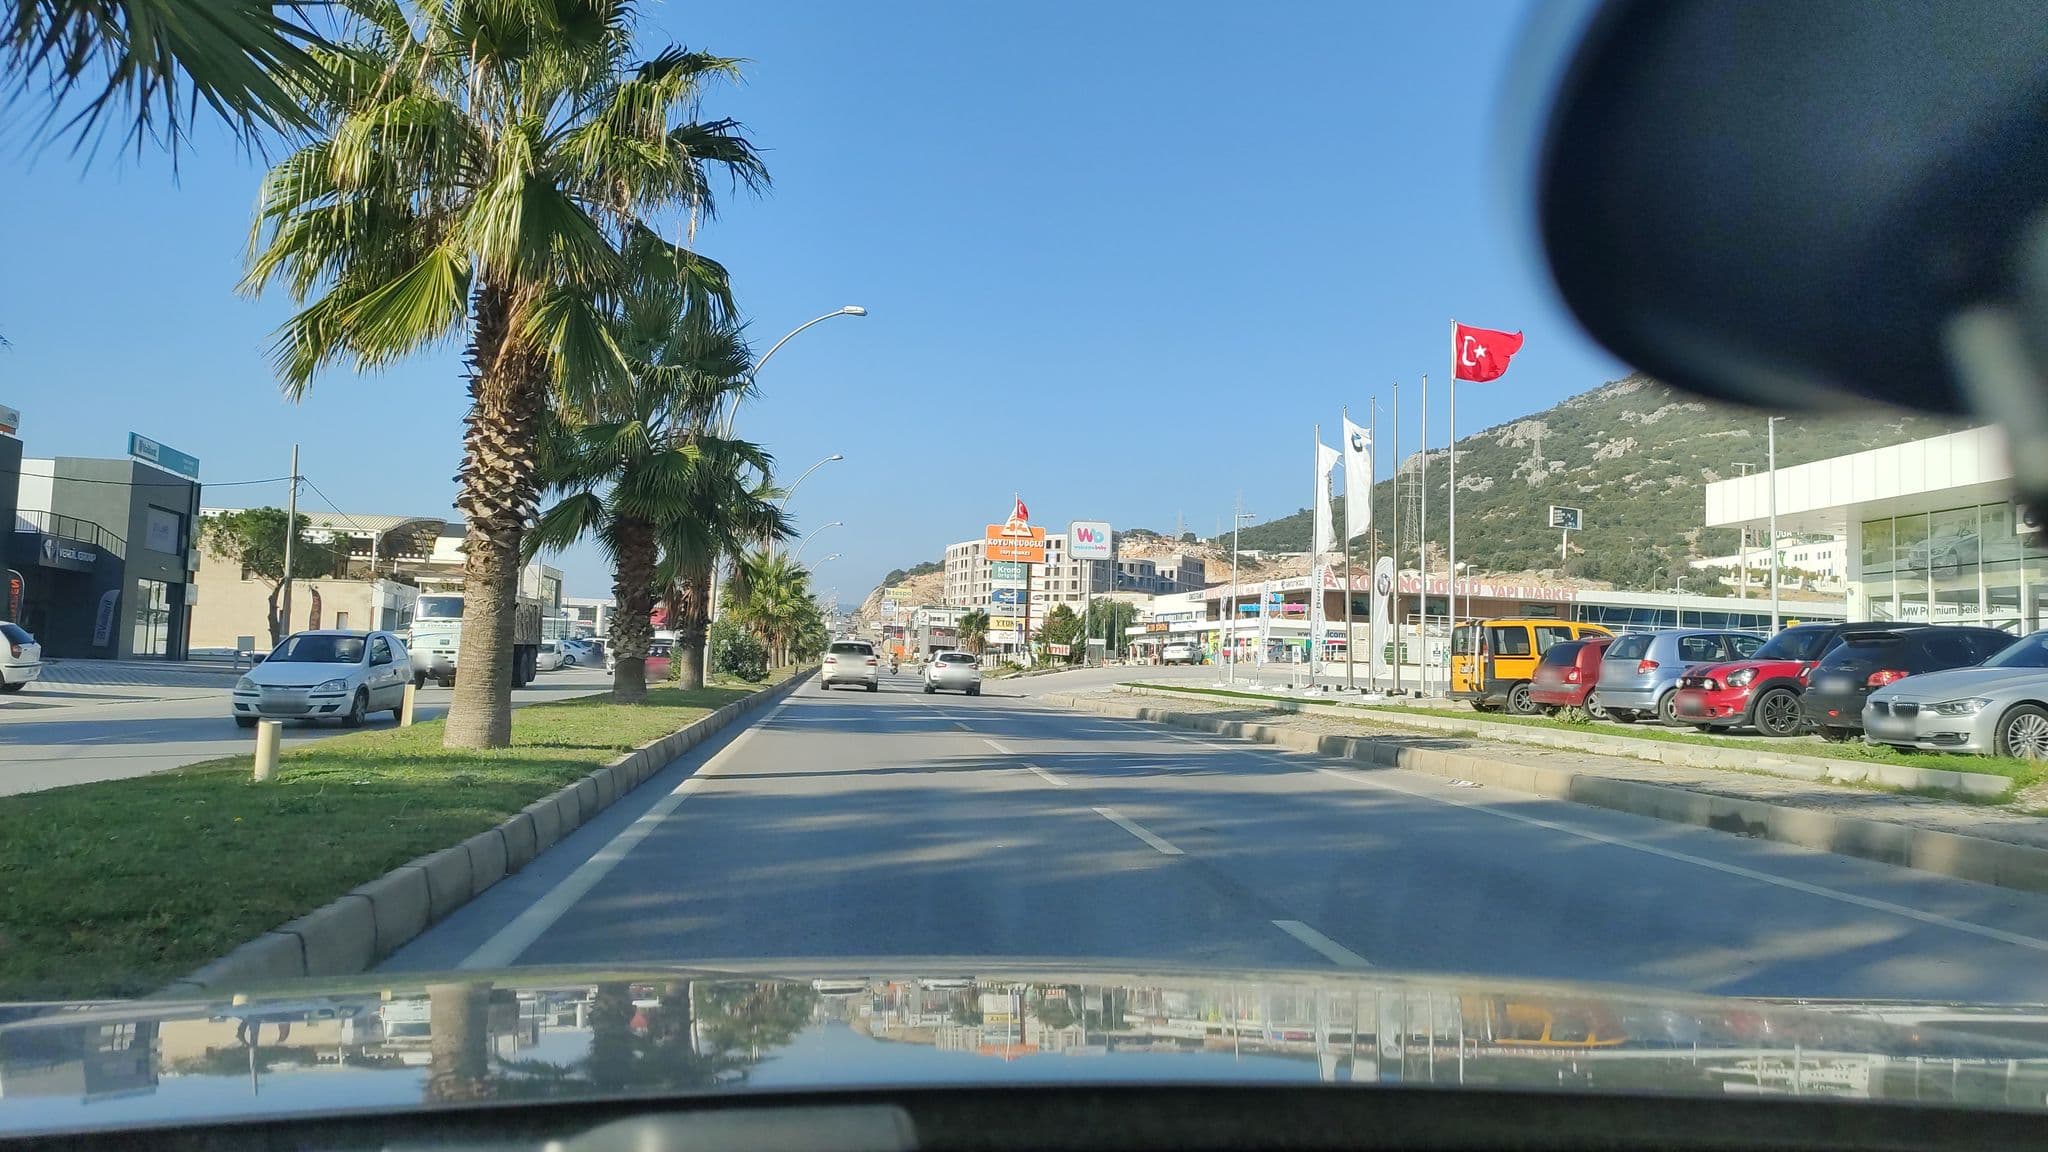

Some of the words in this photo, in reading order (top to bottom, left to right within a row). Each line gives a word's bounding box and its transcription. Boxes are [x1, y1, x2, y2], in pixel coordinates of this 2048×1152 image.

[1490, 585, 1519, 598] YAPI
[1523, 586, 1578, 601] MARKET
[1920, 606, 1957, 617] Prmium
